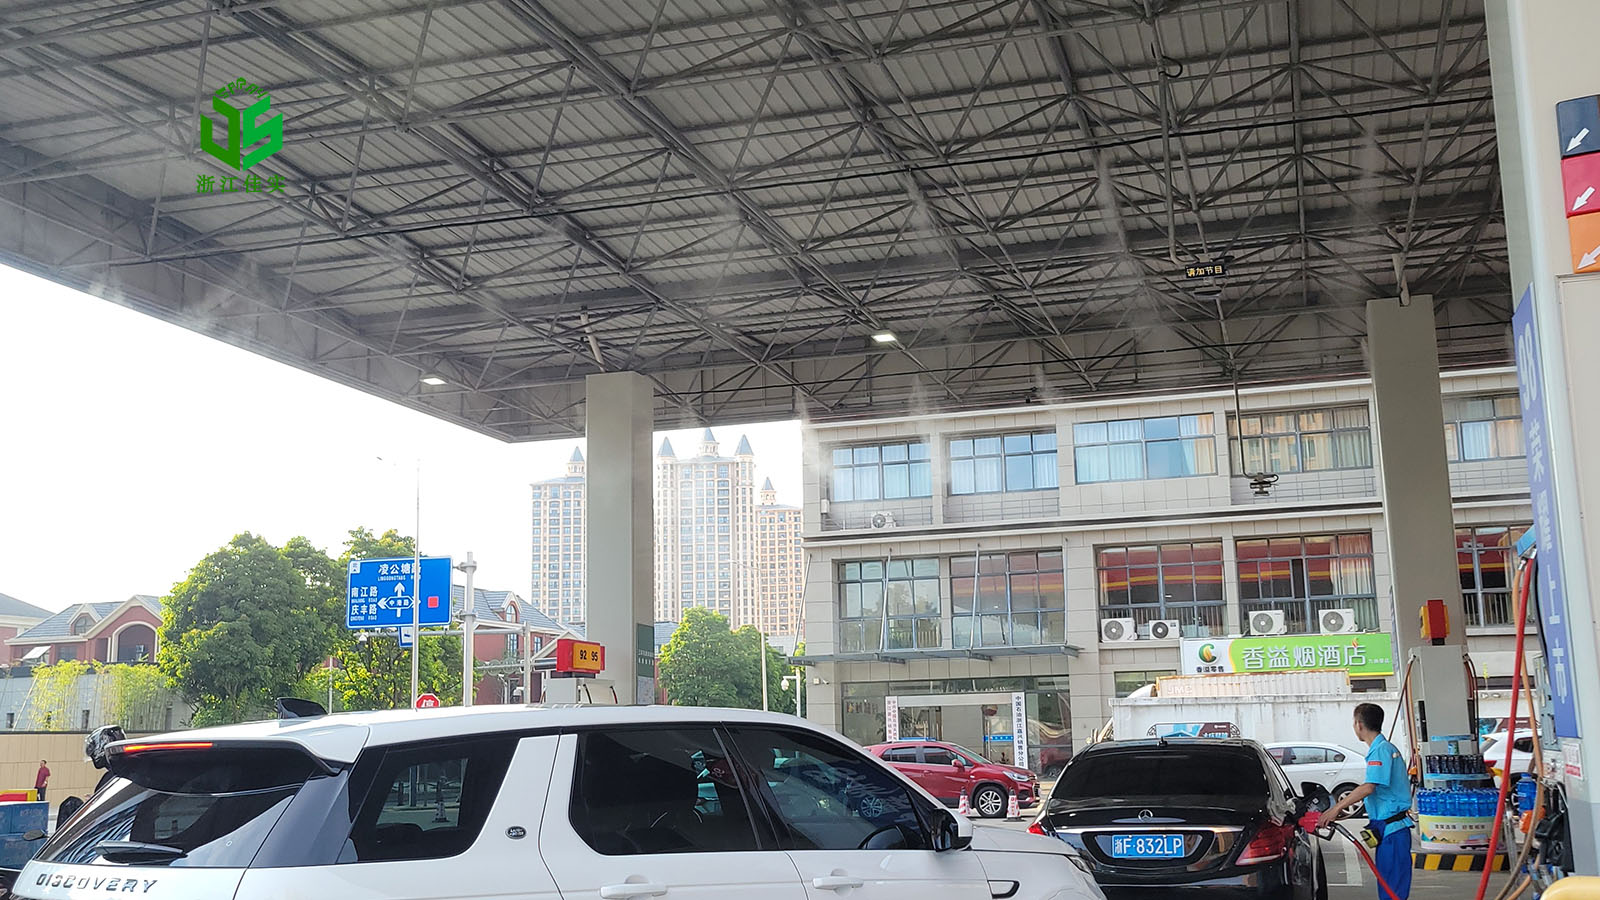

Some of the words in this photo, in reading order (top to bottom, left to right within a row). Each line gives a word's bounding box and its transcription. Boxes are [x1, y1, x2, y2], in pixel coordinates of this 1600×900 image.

[351, 586, 378, 598] 南江路
[351, 604, 377, 615] 庆丰路
[580, 650, 587, 660] 92
[591, 651, 598, 661] 95
[1242, 644, 1366, 669] 香溢烟酒店
[36, 873, 158, 893] DISCOVERY
